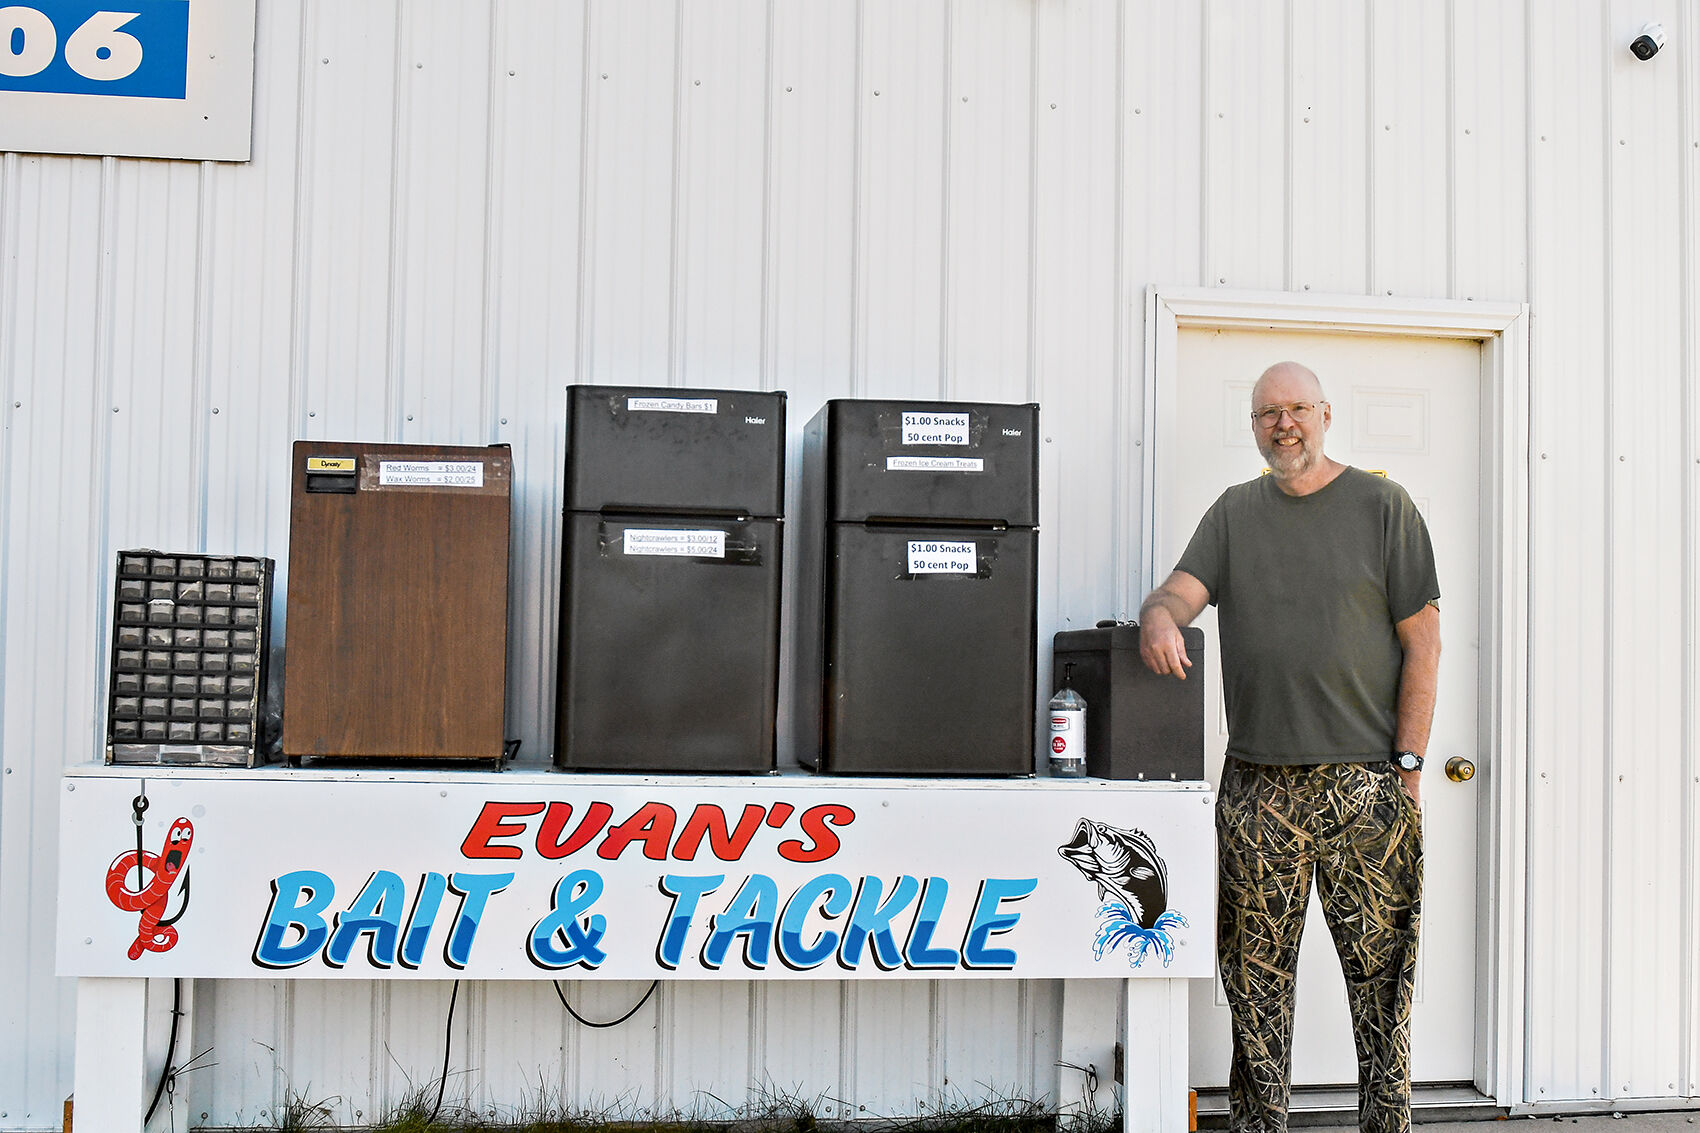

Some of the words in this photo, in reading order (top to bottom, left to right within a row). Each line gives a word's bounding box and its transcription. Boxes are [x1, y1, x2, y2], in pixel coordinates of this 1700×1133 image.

[633, 400, 659, 408] Frozen
[661, 401, 683, 410] Candy
[686, 402, 702, 410] Bars
[704, 403, 713, 411] $1
[745, 416, 766, 425] Haier
[905, 416, 931, 426] $1.00
[933, 417, 966, 426] Snacks
[1002, 428, 1022, 436] Haier
[907, 433, 919, 442] 50
[921, 433, 942, 442] cent
[944, 434, 963, 444] Pop
[403, 464, 429, 472] Worms
[445, 464, 476, 472] $3.00/24
[893, 459, 917, 467] Frozen
[918, 459, 929, 467] Ice
[931, 460, 954, 468] Cream
[956, 460, 978, 468] Treats
[404, 475, 431, 483] Worms
[630, 534, 678, 543] Nightcrawlers
[687, 535, 718, 543] $3.00/12
[630, 545, 678, 553] Nightcrawlers
[911, 544, 937, 553] $1.00
[940, 544, 972, 554] Snacks
[913, 560, 925, 569] 50
[927, 560, 948, 569] cent
[950, 561, 969, 571] Pop
[460, 800, 856, 863] EVAN'S
[251, 869, 515, 970] BAIT
[525, 869, 608, 971] &
[655, 873, 1038, 971] TACKLE
